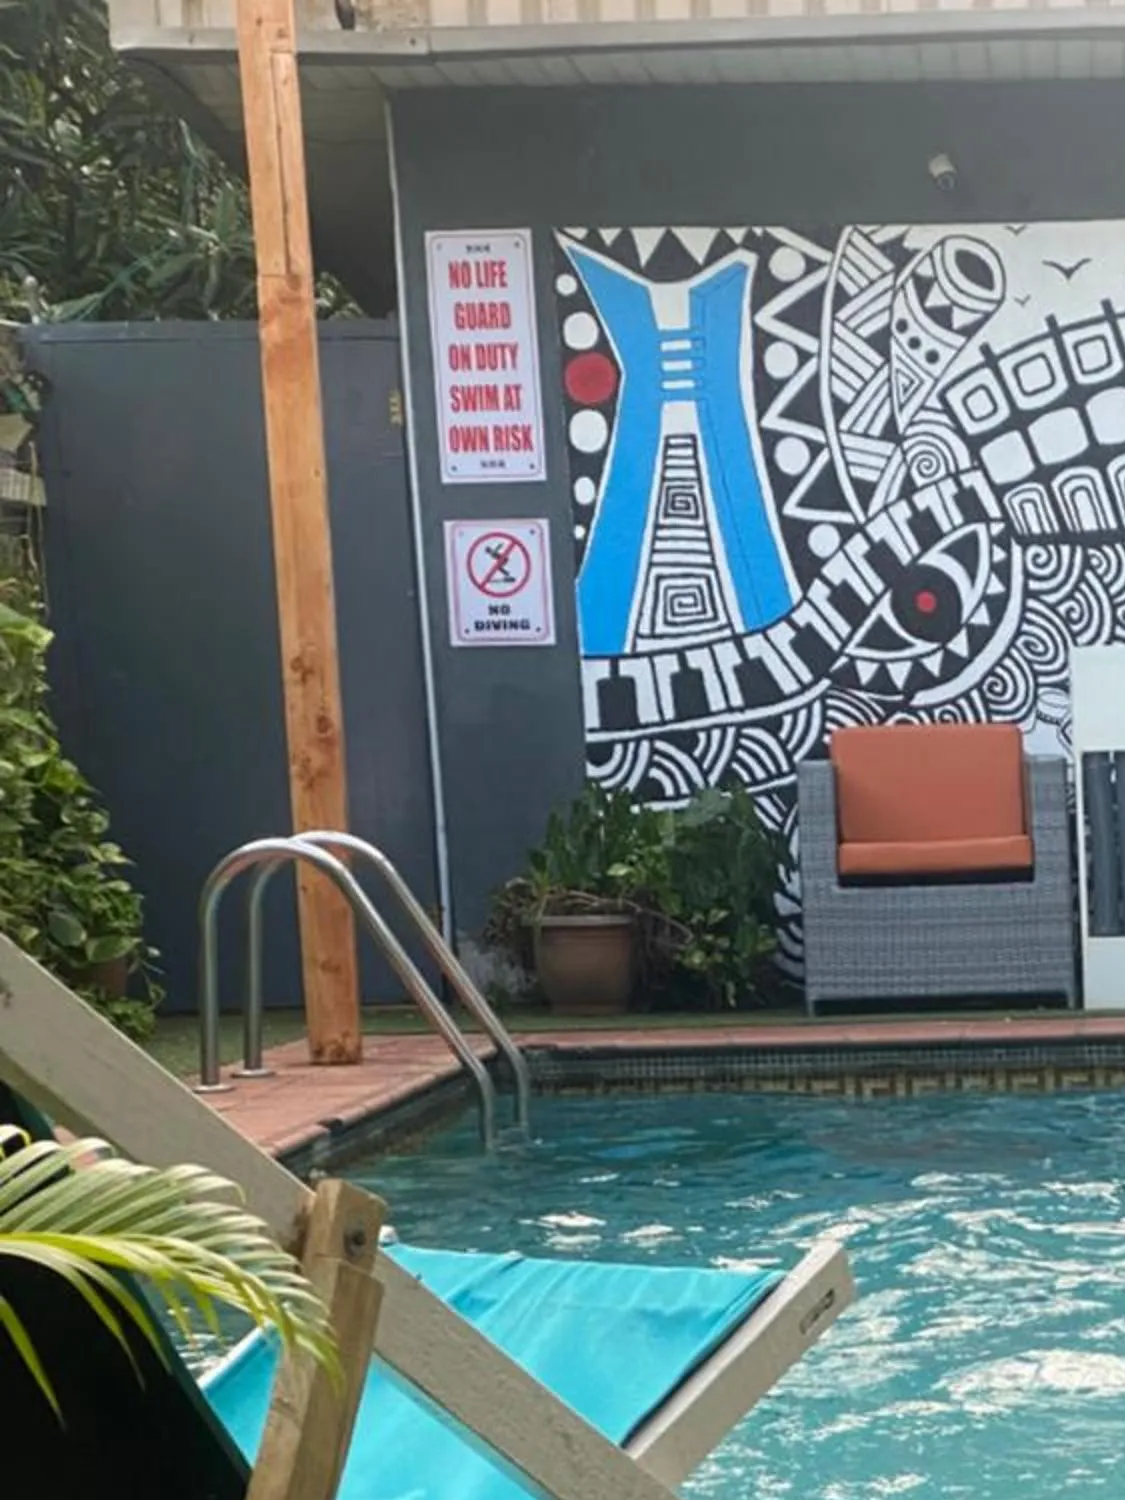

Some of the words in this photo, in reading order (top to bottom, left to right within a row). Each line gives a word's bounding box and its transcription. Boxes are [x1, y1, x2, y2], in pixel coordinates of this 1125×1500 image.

[448, 260, 472, 289] NO
[475, 259, 508, 289] LIFE
[454, 301, 512, 330] GUARD
[448, 343, 472, 372] ON
[475, 342, 518, 371] DUTY
[449, 384, 499, 412] SWIM
[503, 384, 522, 411] AT
[448, 425, 489, 452] OWN
[493, 424, 534, 452] RISK
[488, 604, 511, 616] NO
[474, 619, 531, 631] DIVING
